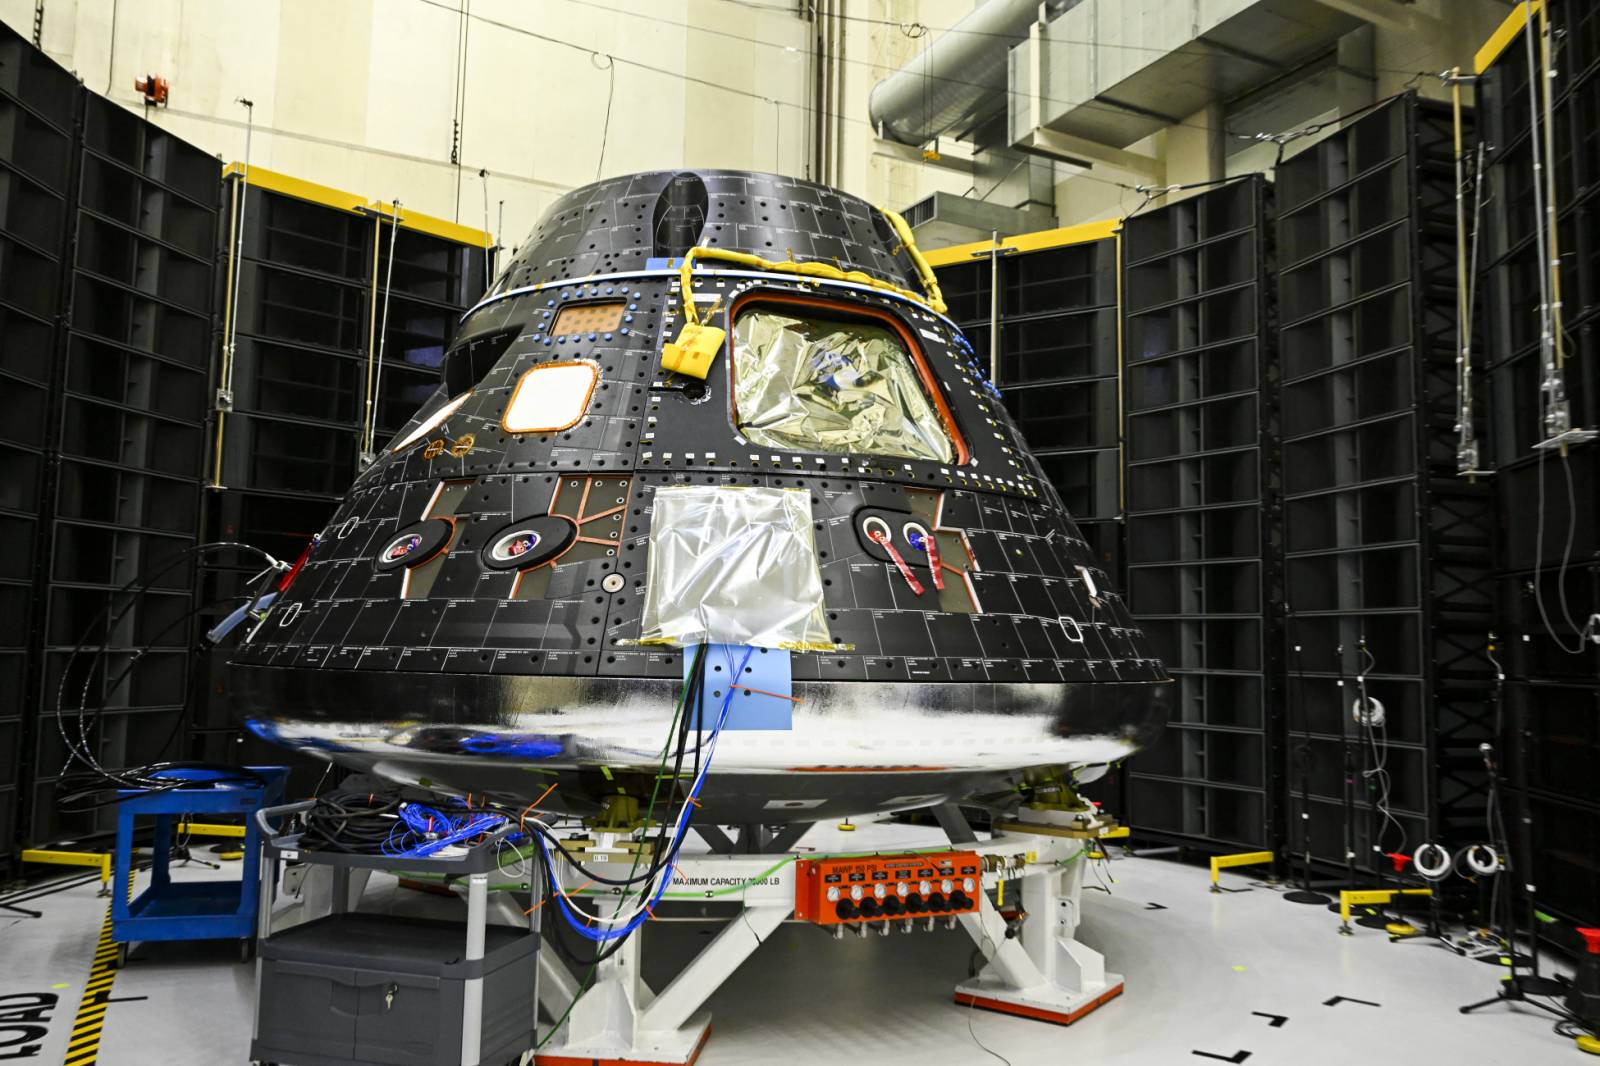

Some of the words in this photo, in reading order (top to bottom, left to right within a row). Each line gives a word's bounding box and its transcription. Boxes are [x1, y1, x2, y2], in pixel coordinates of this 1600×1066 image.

[832, 865, 853, 873] MAWP
[866, 864, 877, 872] PSI
[673, 877, 708, 886] MAXIMUM
[710, 877, 746, 886] CAPACITY
[770, 877, 780, 886] LB
[0, 992, 59, 1060] LOAD
